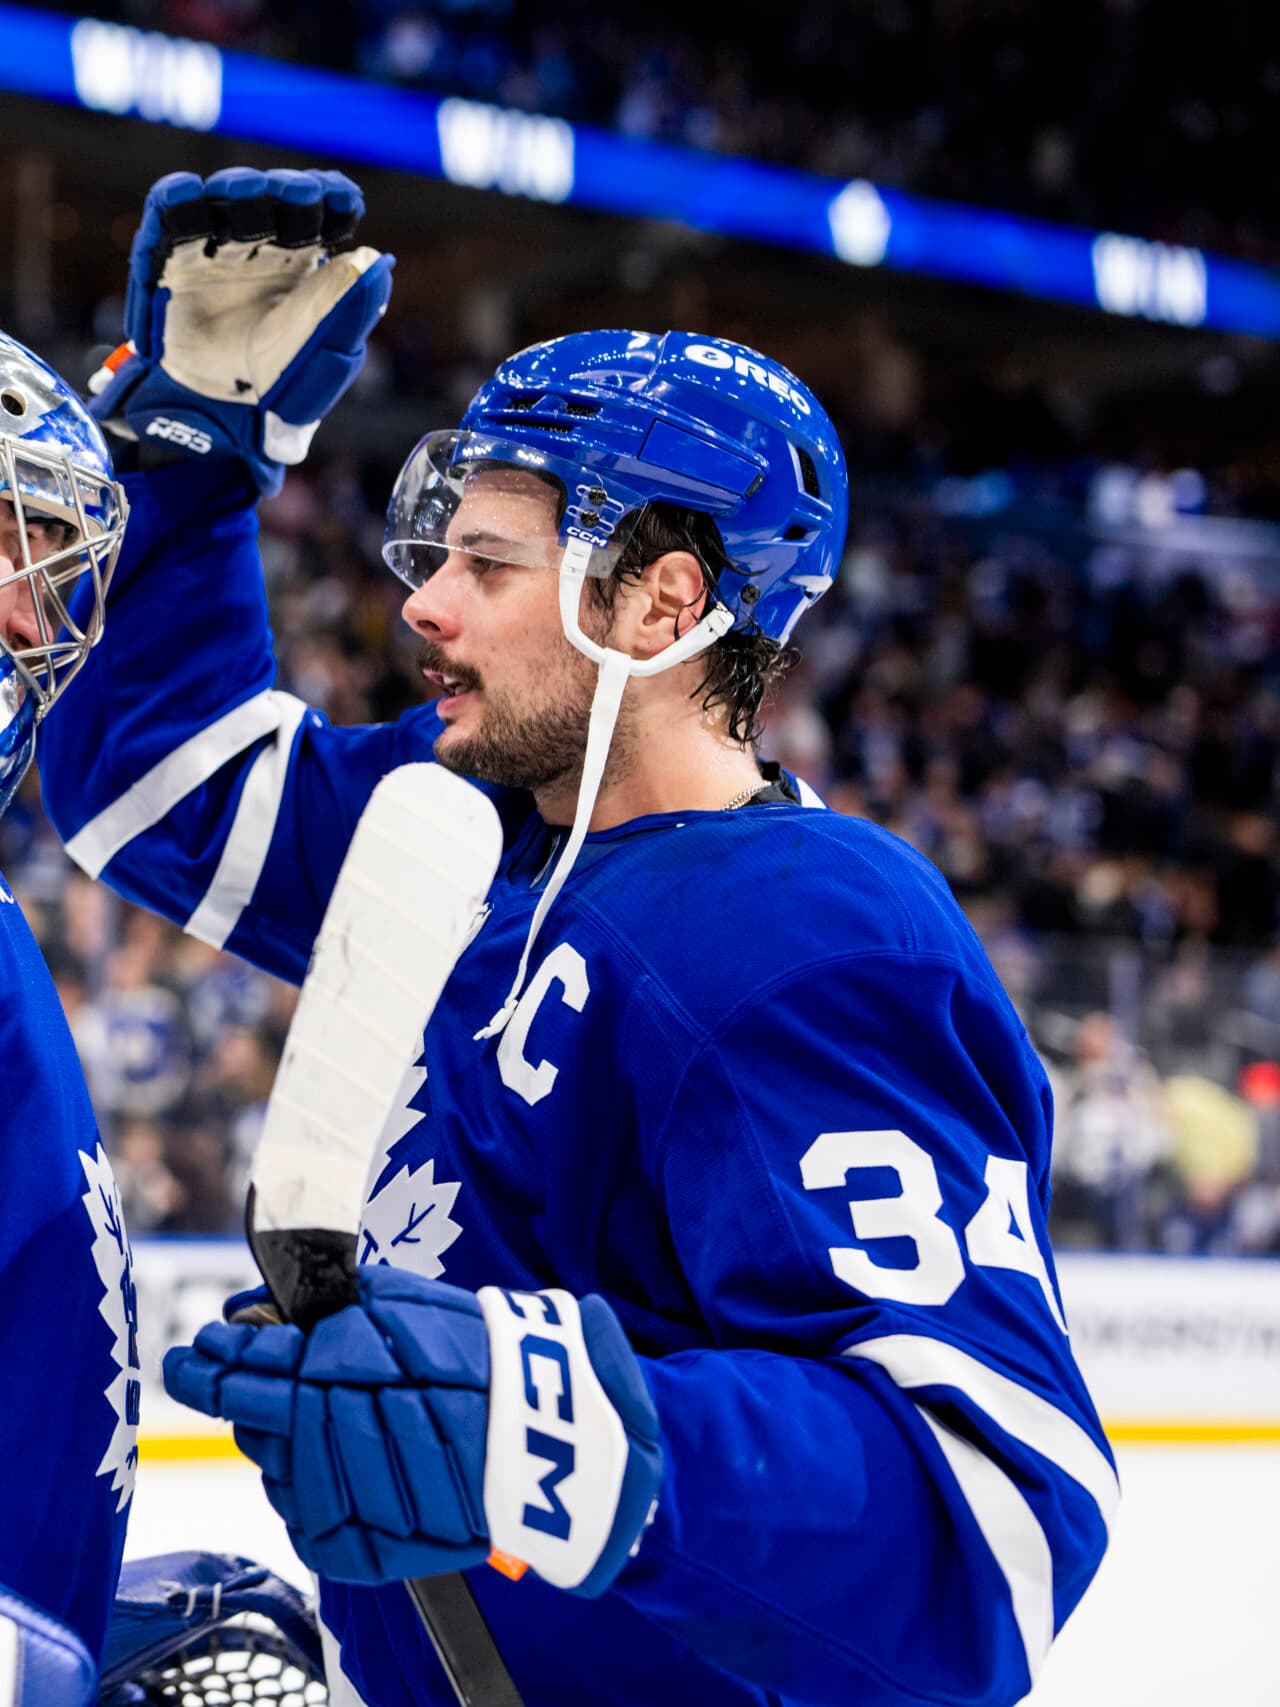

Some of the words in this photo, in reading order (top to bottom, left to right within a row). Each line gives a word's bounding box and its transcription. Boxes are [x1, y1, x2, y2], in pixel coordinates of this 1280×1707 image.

[684, 344, 811, 415] OREO
[566, 526, 608, 547] CCM
[496, 942, 591, 1106] C
[800, 1130, 1069, 1336] 34
